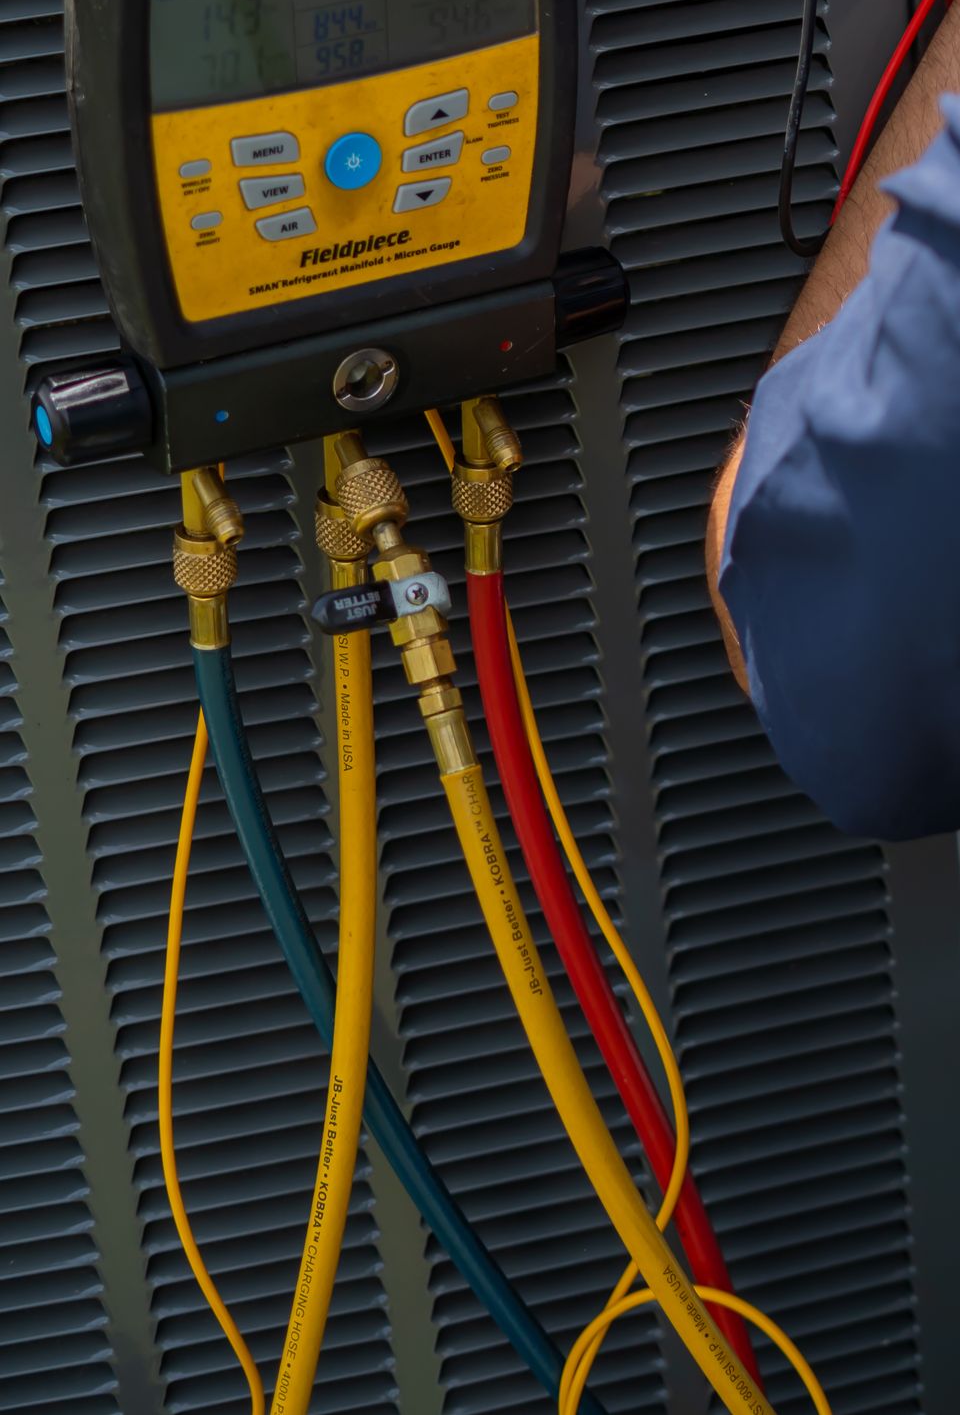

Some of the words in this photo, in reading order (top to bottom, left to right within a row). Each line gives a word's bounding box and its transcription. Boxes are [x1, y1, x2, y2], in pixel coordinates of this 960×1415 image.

[252, 145, 284, 160] MENU
[419, 149, 451, 163] ENTER
[262, 185, 289, 198] VIEW
[280, 222, 298, 233] AIR
[282, 267, 338, 287] Refrigerant
[340, 256, 384, 274] Manifold
[394, 247, 428, 261] Micron
[429, 239, 461, 253] Gauge
[299, 229, 411, 268] Fieldpiece
[347, 603, 377, 621] JUST
[339, 653, 350, 679] W.P.
[340, 693, 351, 726] Made
[342, 730, 351, 741] in
[342, 744, 353, 772] USA
[502, 899, 523, 942] Better
[520, 943, 543, 996] JB-Just
[329, 1075, 343, 1125] JB-Just
[322, 1128, 337, 1171] Better
[295, 1244, 318, 1319] CHARGING
[662, 1264, 681, 1288] USA
[686, 1302, 707, 1333] Made
[287, 1320, 302, 1361] HOSE
[277, 1370, 291, 1402] 4000
[724, 1362, 738, 1383] PSI
